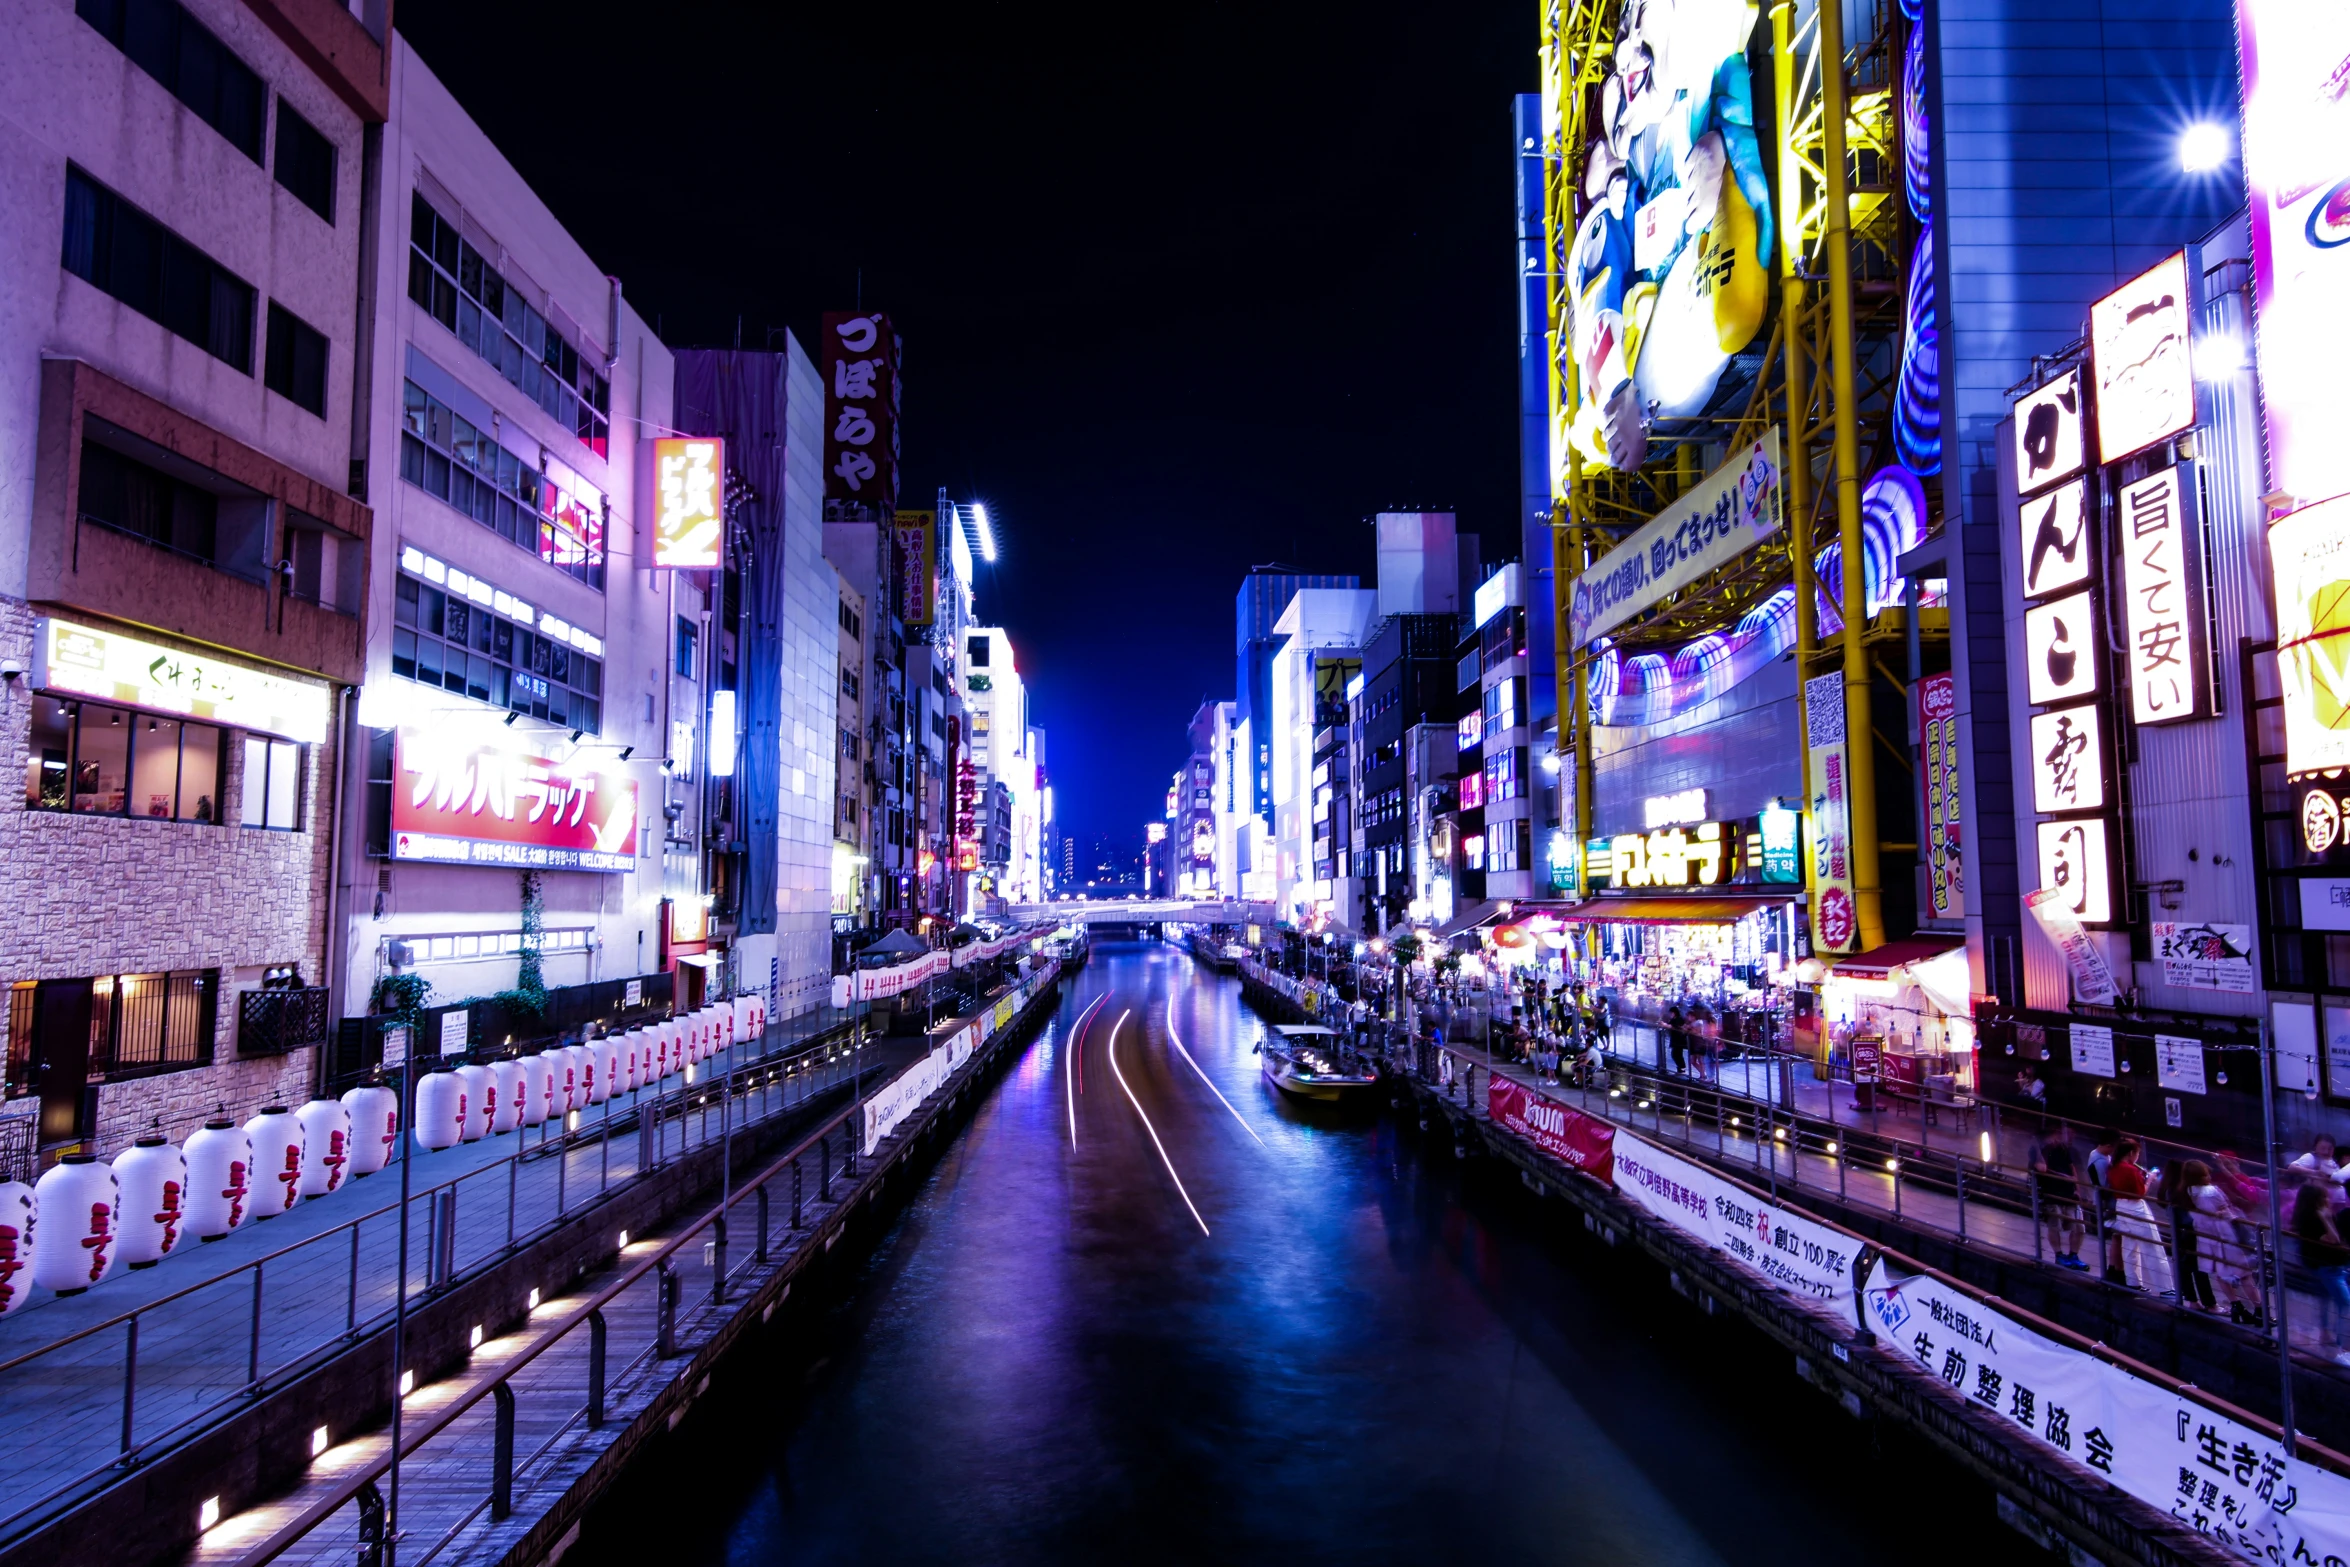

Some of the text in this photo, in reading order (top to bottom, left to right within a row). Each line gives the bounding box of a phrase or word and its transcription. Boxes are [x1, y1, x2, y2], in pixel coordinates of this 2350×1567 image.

[834, 313, 884, 491] づぼらや
[2131, 480, 2182, 713] 旨くて安い
[503, 845, 527, 863] SALE
[548, 850, 578, 867] 환영합니다
[579, 853, 614, 868] WELCOME
[1814, 794, 1830, 878] オープン
[1715, 1195, 1754, 1232] 令和四年
[1757, 1209, 1771, 1245] 祝
[1917, 1297, 1997, 1355] 一般社団法人
[1914, 1331, 2114, 1474] 生前整理協会
